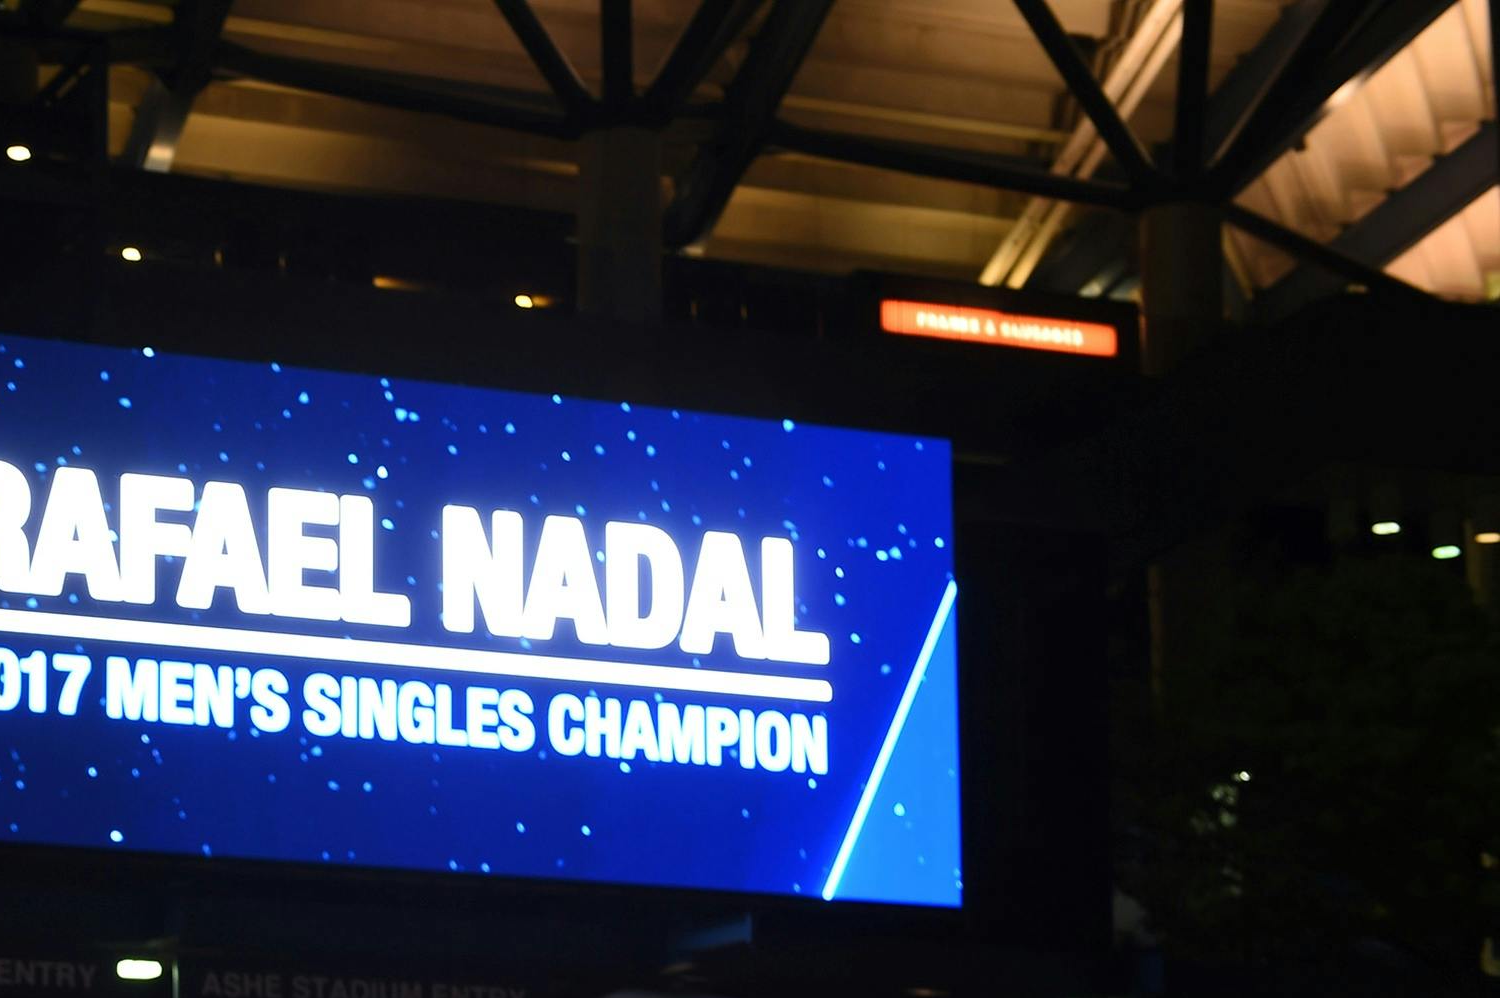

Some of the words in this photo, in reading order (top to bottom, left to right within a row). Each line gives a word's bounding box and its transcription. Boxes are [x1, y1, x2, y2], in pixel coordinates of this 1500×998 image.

[442, 505, 831, 665] NADAL
[105, 656, 291, 733] MEN'S
[301, 671, 537, 753] SINGLES
[547, 696, 830, 776] CHAMPION
